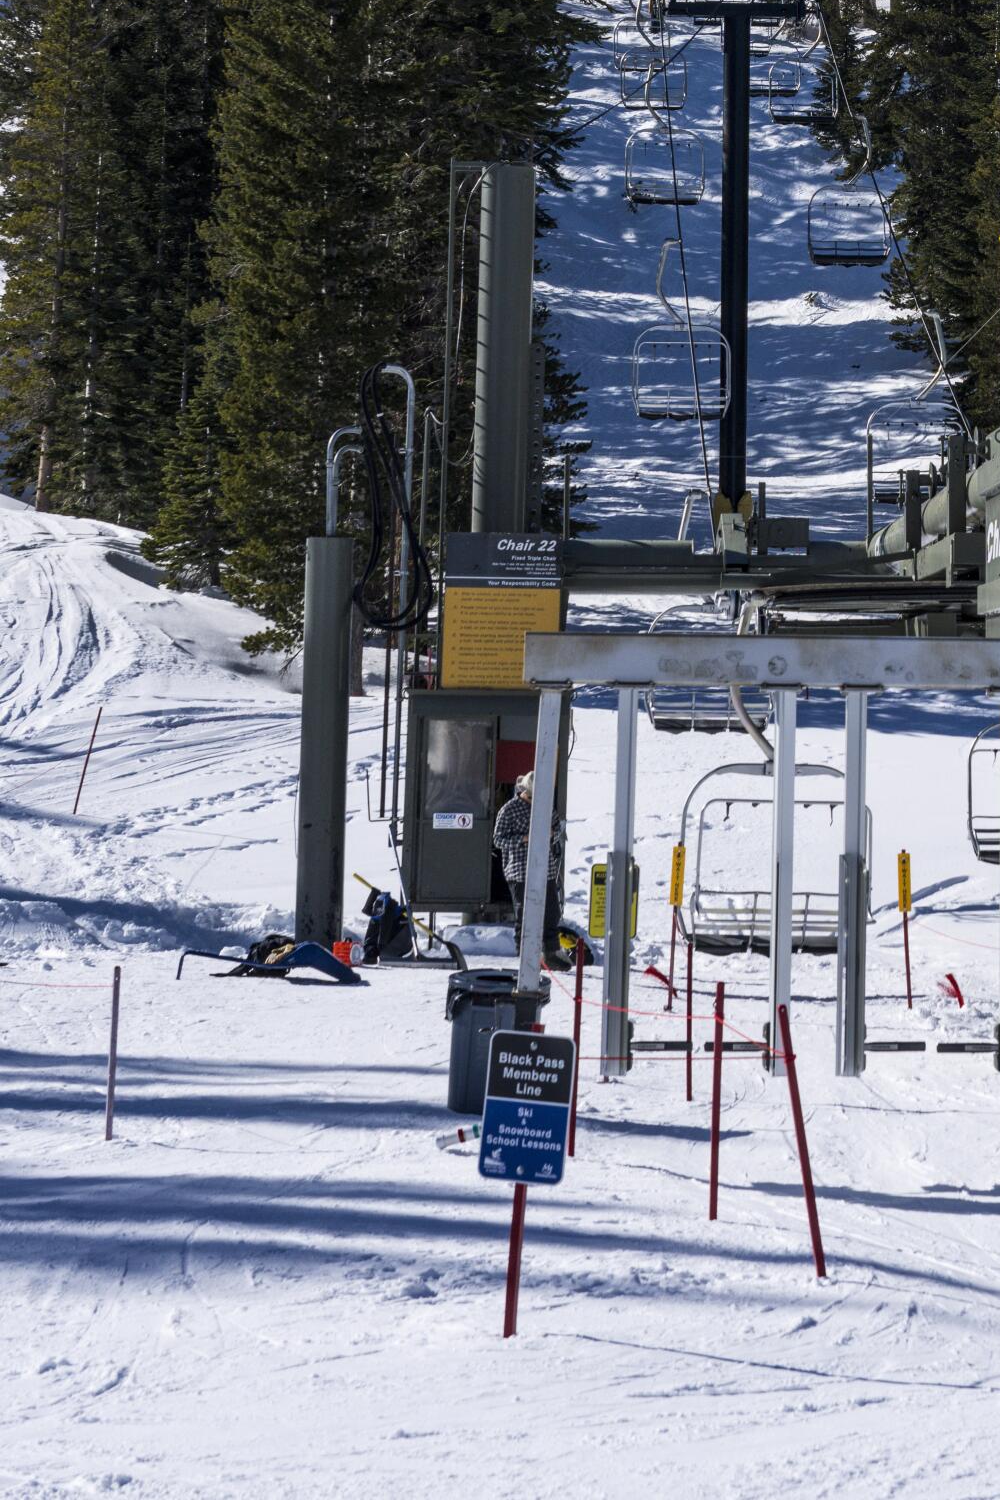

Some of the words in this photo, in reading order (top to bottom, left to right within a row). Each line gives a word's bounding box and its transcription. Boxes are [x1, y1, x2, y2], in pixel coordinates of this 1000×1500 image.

[497, 539, 536, 552] Chair
[537, 540, 557, 552] 22
[501, 580, 540, 588] Responsibility
[498, 1051, 532, 1066] Black
[535, 1055, 565, 1070] Pass
[502, 1067, 559, 1083] Members
[515, 1083, 542, 1097] Line
[517, 1106, 533, 1118] Ski
[498, 1124, 552, 1139] Snowboard
[486, 1134, 519, 1147] School
[521, 1139, 562, 1152] Lessons
